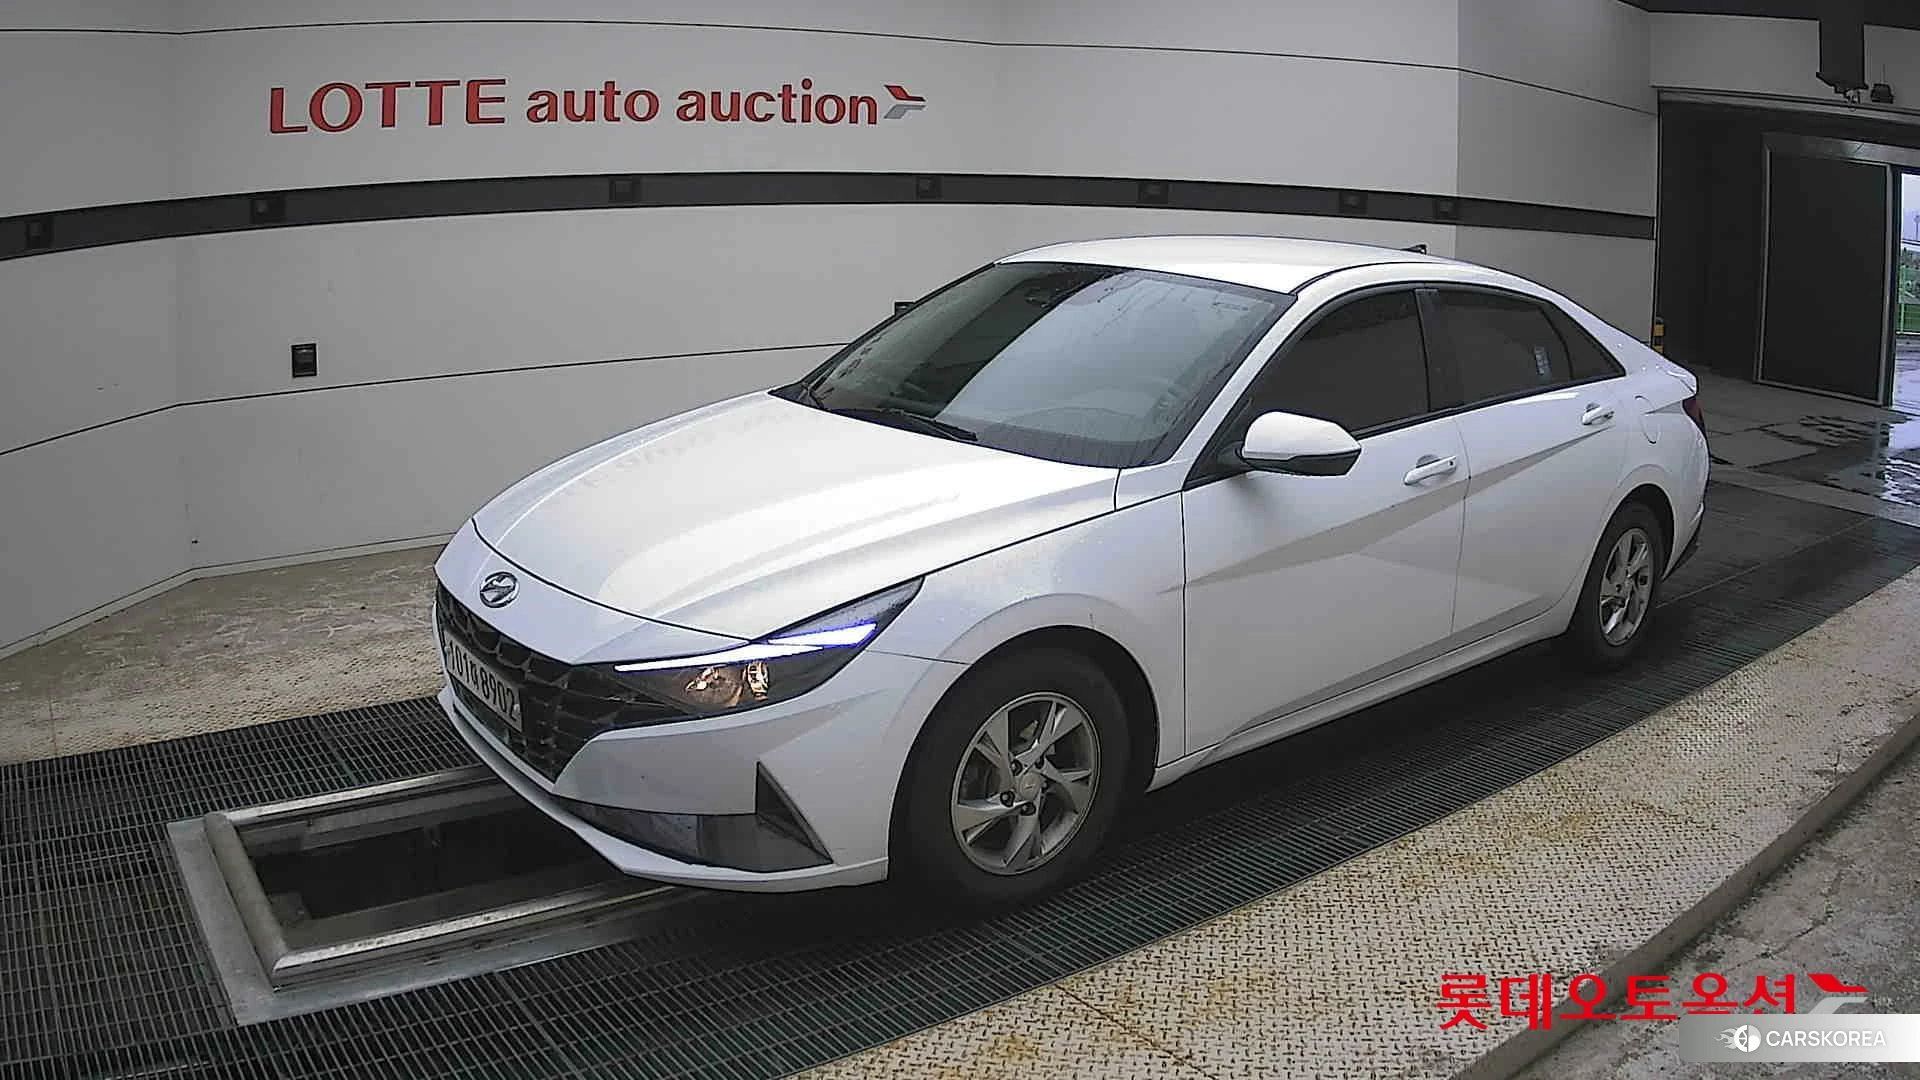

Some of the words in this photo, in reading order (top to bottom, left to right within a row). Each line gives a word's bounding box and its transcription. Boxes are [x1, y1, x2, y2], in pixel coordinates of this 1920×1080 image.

[269, 78, 507, 134] LOTTE
[526, 80, 661, 124] auto
[676, 78, 880, 126] auction
